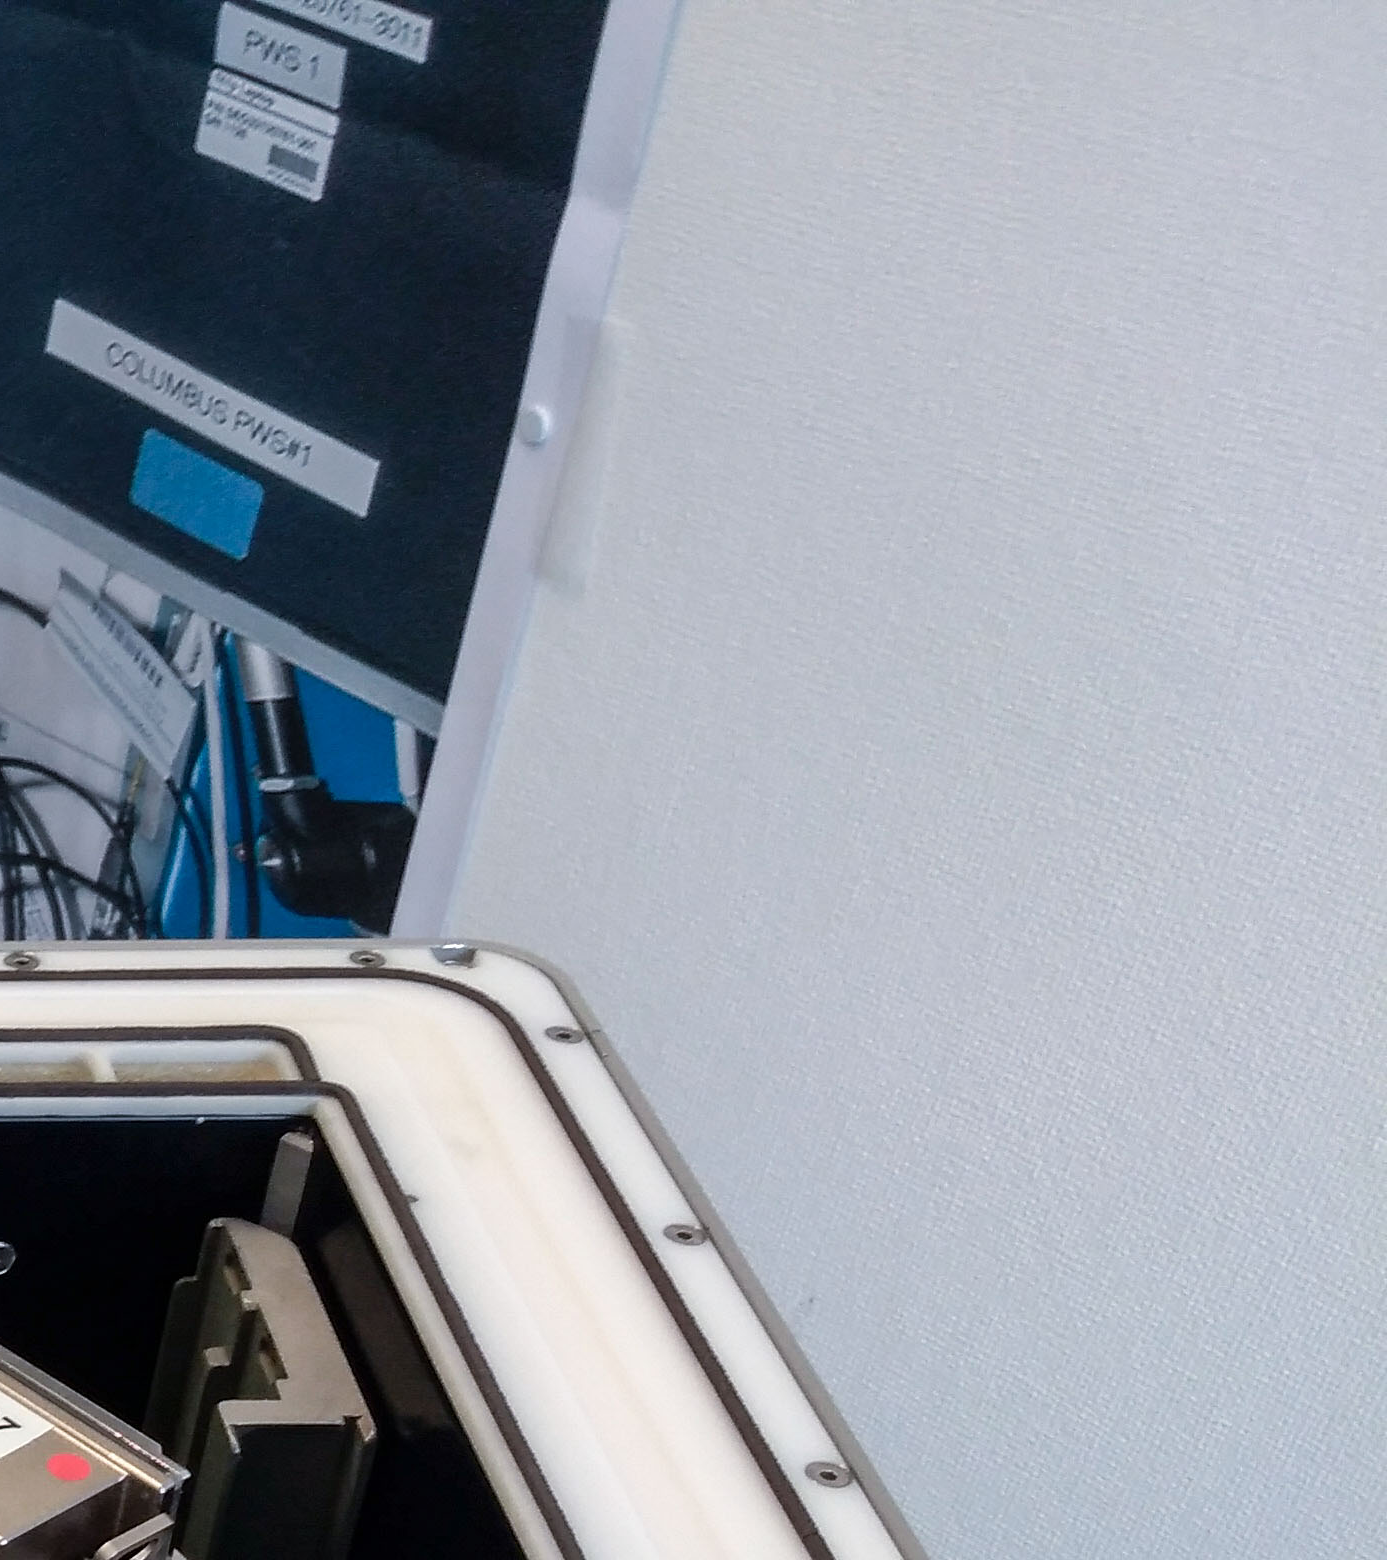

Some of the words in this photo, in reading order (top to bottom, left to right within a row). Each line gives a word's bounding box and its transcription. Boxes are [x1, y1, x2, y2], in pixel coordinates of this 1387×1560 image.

[243, 29, 301, 73] PWS
[310, 55, 320, 80] 1
[106, 342, 228, 426] COLUMBUS
[232, 410, 313, 467] PWS#1
